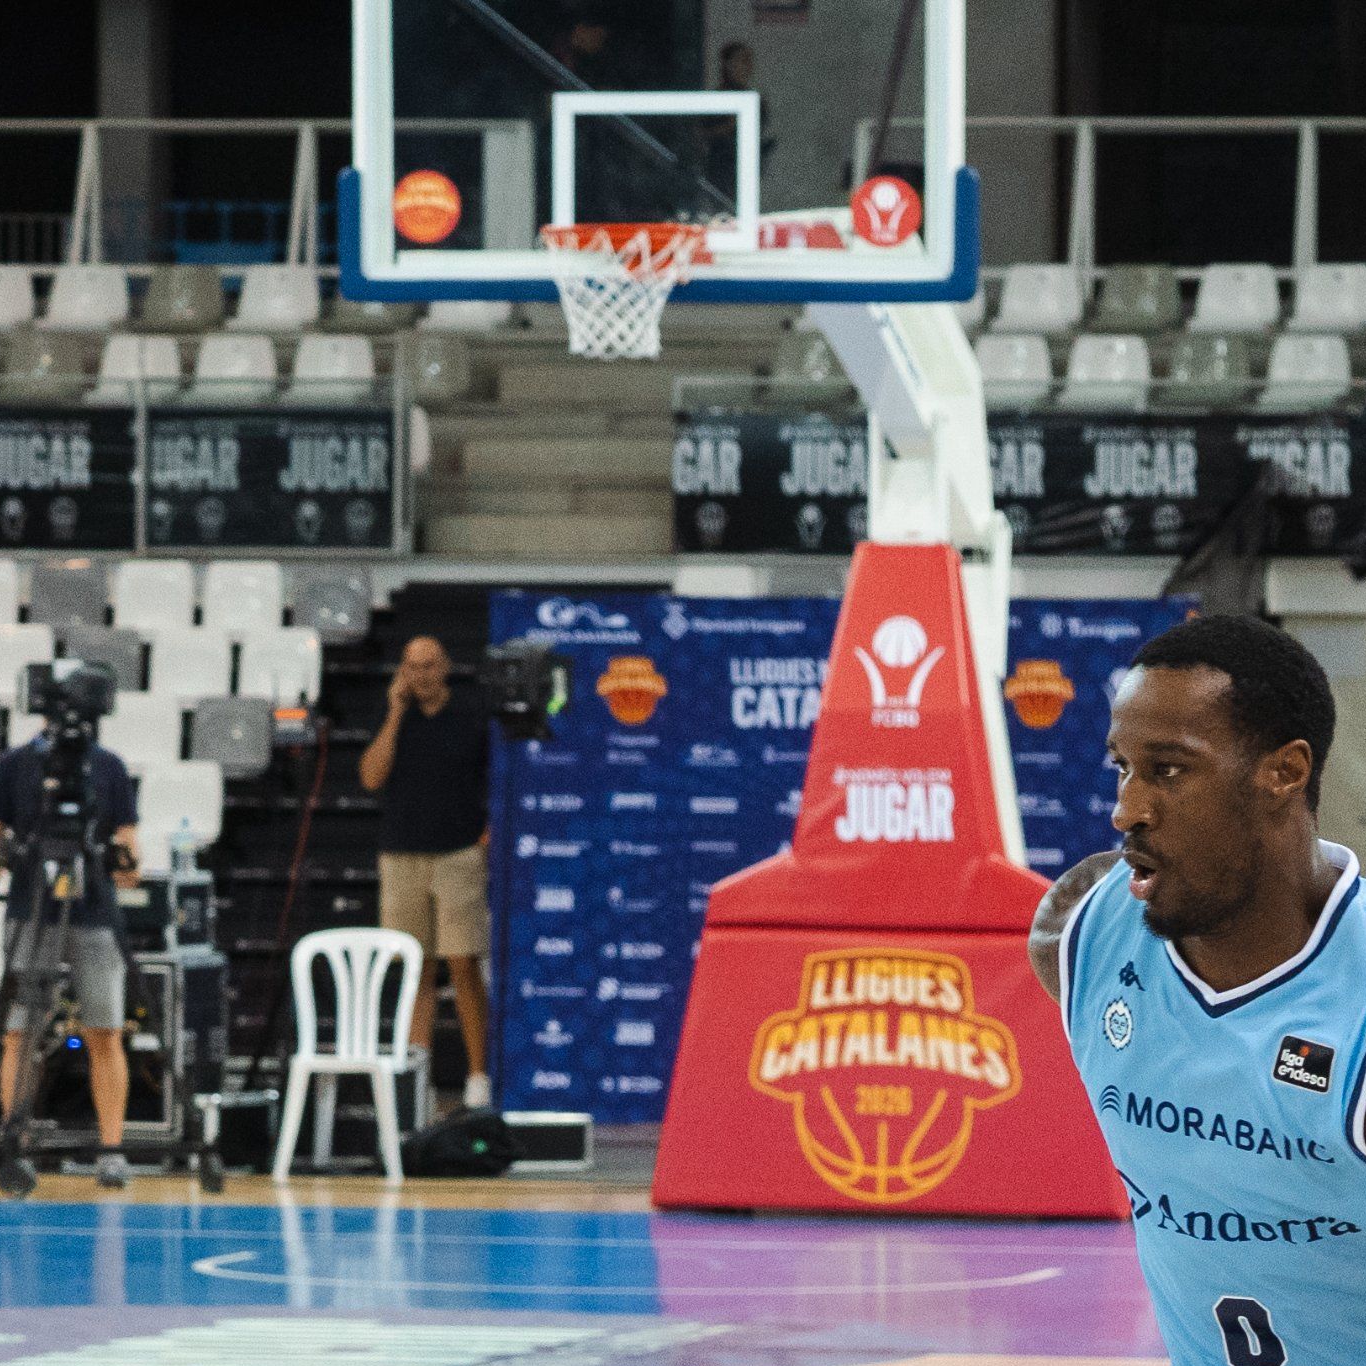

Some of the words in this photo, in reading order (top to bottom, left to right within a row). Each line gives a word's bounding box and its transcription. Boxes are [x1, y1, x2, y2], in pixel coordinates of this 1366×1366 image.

[673, 439, 741, 494] GAR
[780, 441, 868, 495] JUGA
[1083, 442, 1198, 497] JUGAR
[835, 783, 955, 842] JUGAR
[811, 958, 964, 1013] LLIGUES
[759, 1009, 1011, 1089] CATALANES
[1278, 1065, 1327, 1087] endesa
[1281, 1048, 1305, 1066] liga
[1157, 1194, 1362, 1245] Andorra
